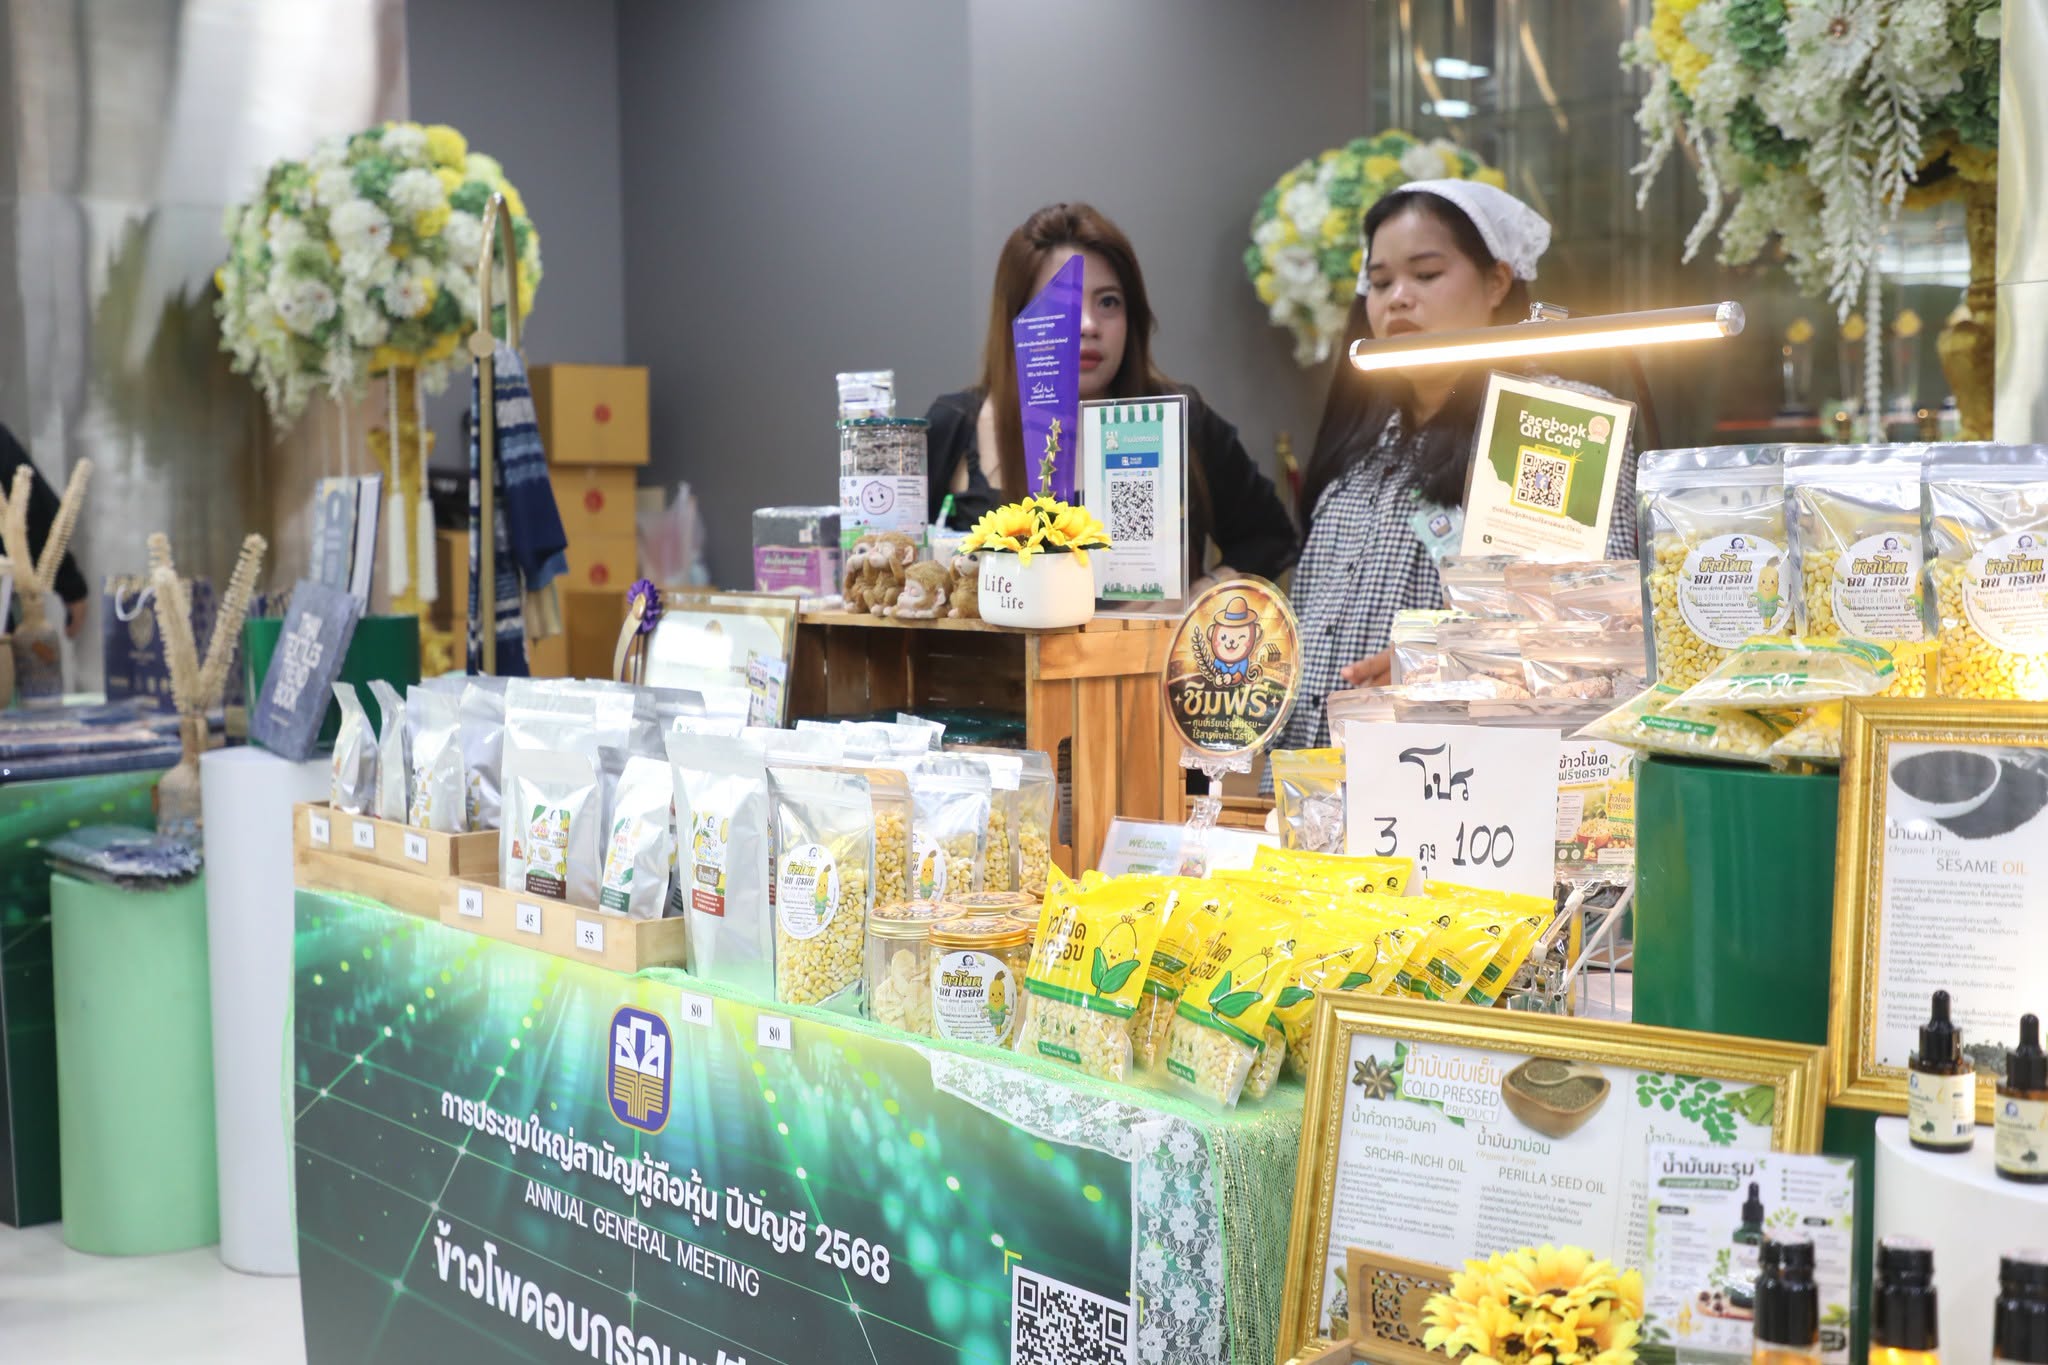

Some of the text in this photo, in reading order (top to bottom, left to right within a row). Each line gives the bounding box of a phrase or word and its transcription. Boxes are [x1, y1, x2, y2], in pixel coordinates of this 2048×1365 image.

[1519, 410, 1587, 437] Facebook
[1520, 423, 1582, 449] QR Code
[1699, 554, 1752, 573] ข้าวโพด
[1852, 555, 1908, 575] ข้าวโพด
[1985, 553, 2044, 576] ข้าวโพด
[985, 574, 1012, 593] Life
[1001, 596, 1024, 609] Life
[1184, 681, 1270, 717] ชิมฟรี
[1399, 742, 1474, 801] โปร
[1559, 750, 1608, 769] ข้าวโพด
[1374, 817, 1397, 857] 3
[1452, 821, 1514, 868] 100
[1889, 846, 1961, 859] Organic Virgin
[1936, 859, 2030, 876] SESAME OIL
[525, 914, 534, 927] 45
[585, 930, 594, 944] 55
[942, 970, 983, 988] ข้าวโพด
[691, 1003, 702, 1018] 80
[769, 1026, 781, 1041] 80
[1405, 1043, 1503, 1087] น้ำมันบีบเย็น
[1403, 1079, 1500, 1108] COLD PRESSED
[1352, 1104, 1437, 1135] น้ำถั่วดาวอินคา
[1446, 1104, 1497, 1122] PRODUCT
[1477, 1125, 1551, 1156] น้ำมันงาม่อน
[1364, 1146, 1469, 1174] SACHA-INCHI OIL
[1663, 1151, 1755, 1180] น้ำมันมะรุม
[441, 1091, 891, 1285] การประชุมใหญ่สามัญผู้ถือหุ้น ปีบัญชี 2568
[1498, 1167, 1607, 1195] PERILLA SEED OIL
[524, 1180, 760, 1297] ANNUAL GENERAL MEETING
